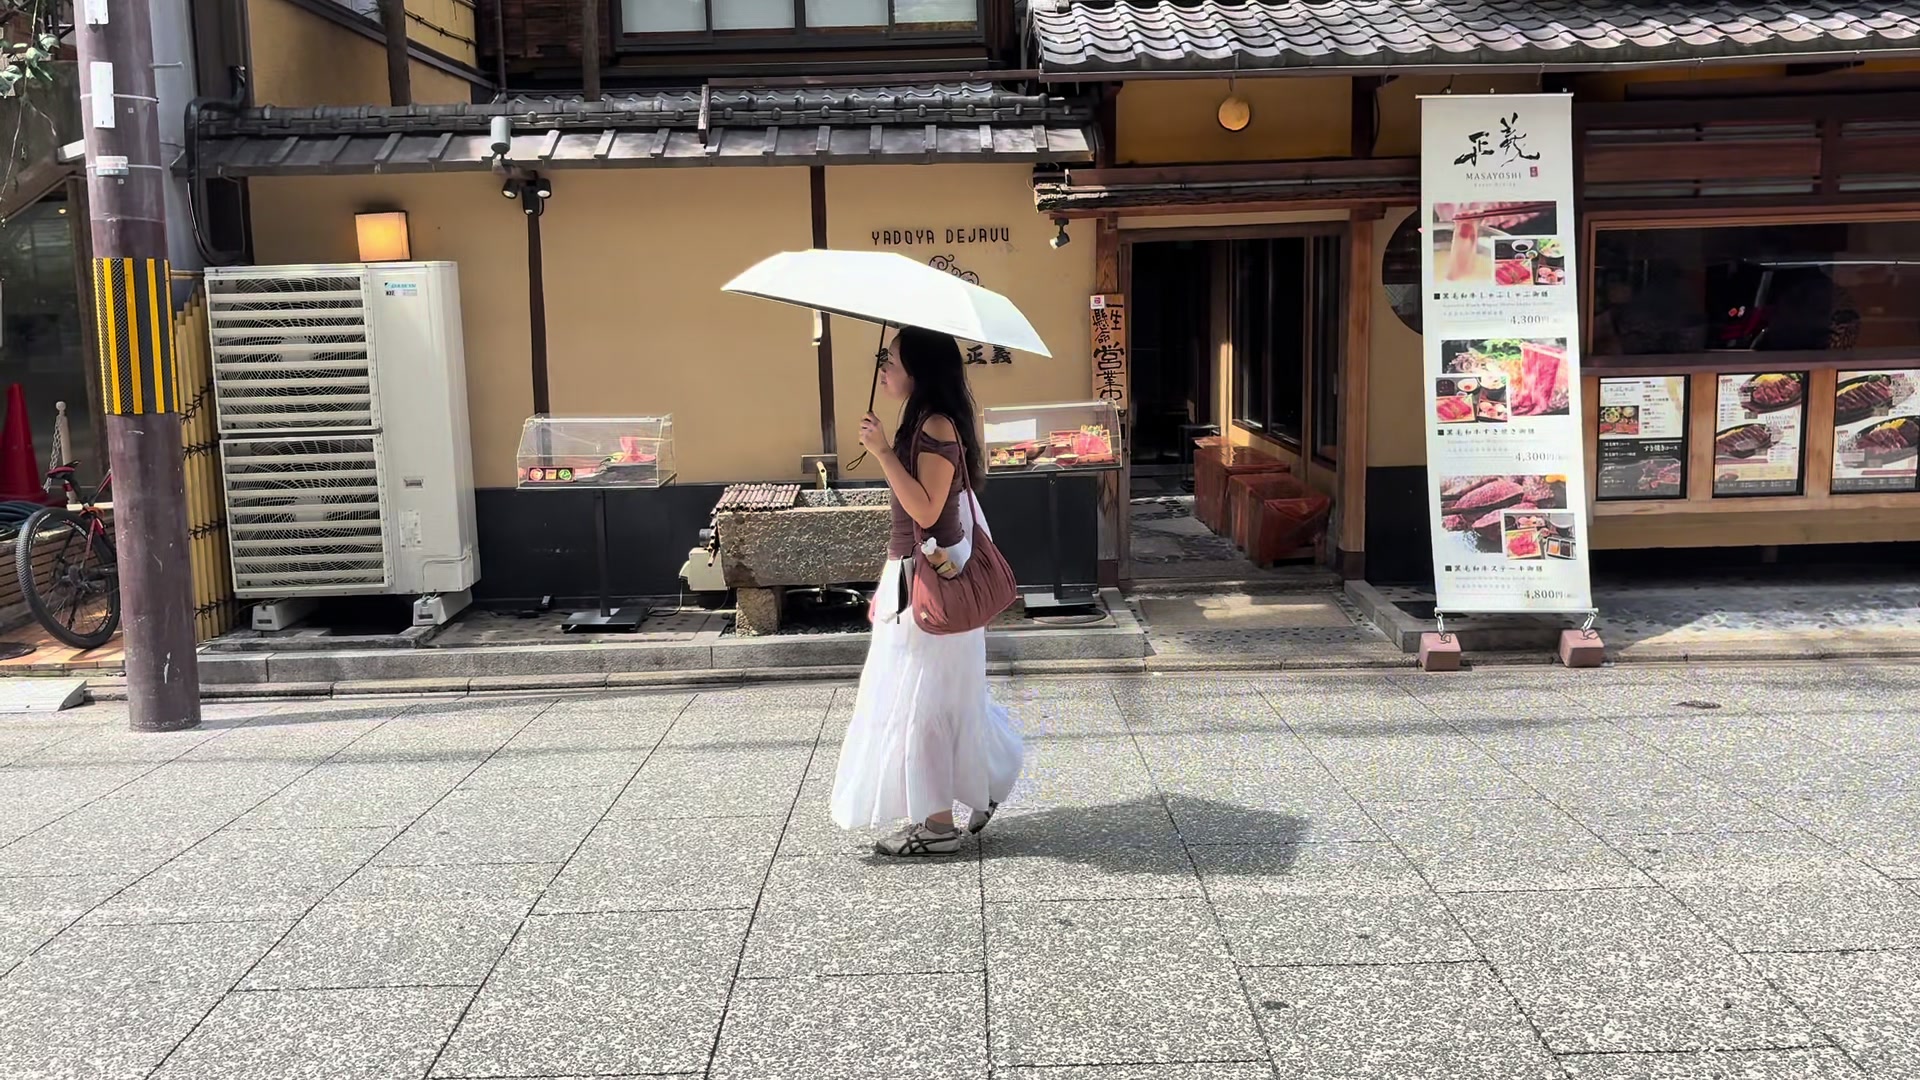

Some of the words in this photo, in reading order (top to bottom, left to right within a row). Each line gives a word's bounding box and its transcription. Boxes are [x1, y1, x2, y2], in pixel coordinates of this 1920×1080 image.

[1466, 172, 1521, 181] MASAYOSHI
[871, 229, 935, 246] YADOYA
[946, 227, 1010, 244] DEJAVU
